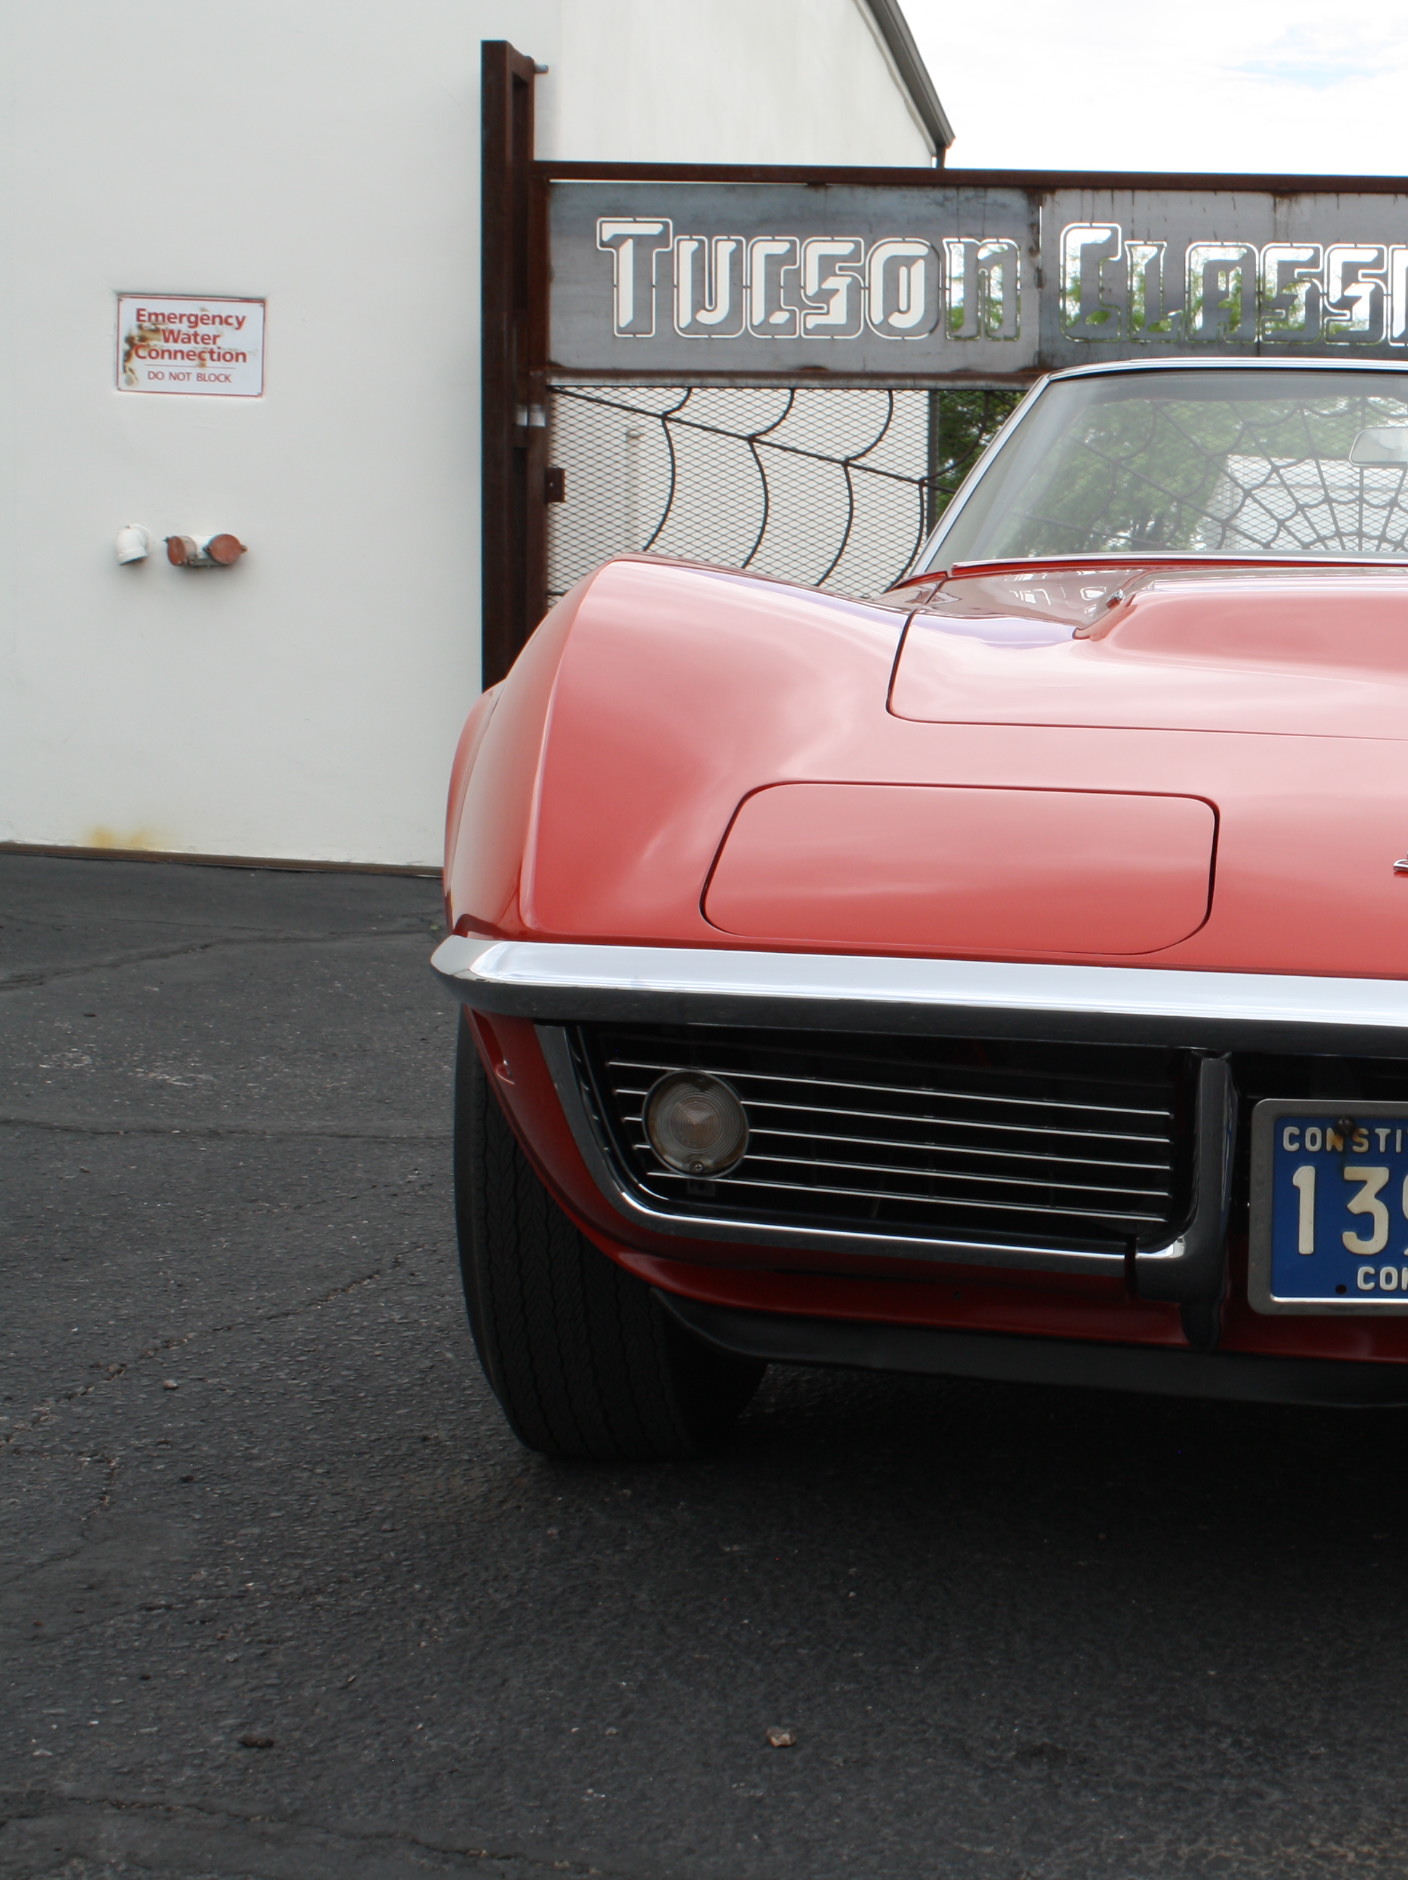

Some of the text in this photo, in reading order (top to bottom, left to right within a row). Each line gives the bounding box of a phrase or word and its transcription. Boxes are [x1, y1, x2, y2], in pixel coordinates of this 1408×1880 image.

[136, 308, 246, 330] Emergency
[161, 329, 220, 345] Water
[134, 344, 247, 363] Connection
[147, 370, 232, 383] DO NOT BLOCK
